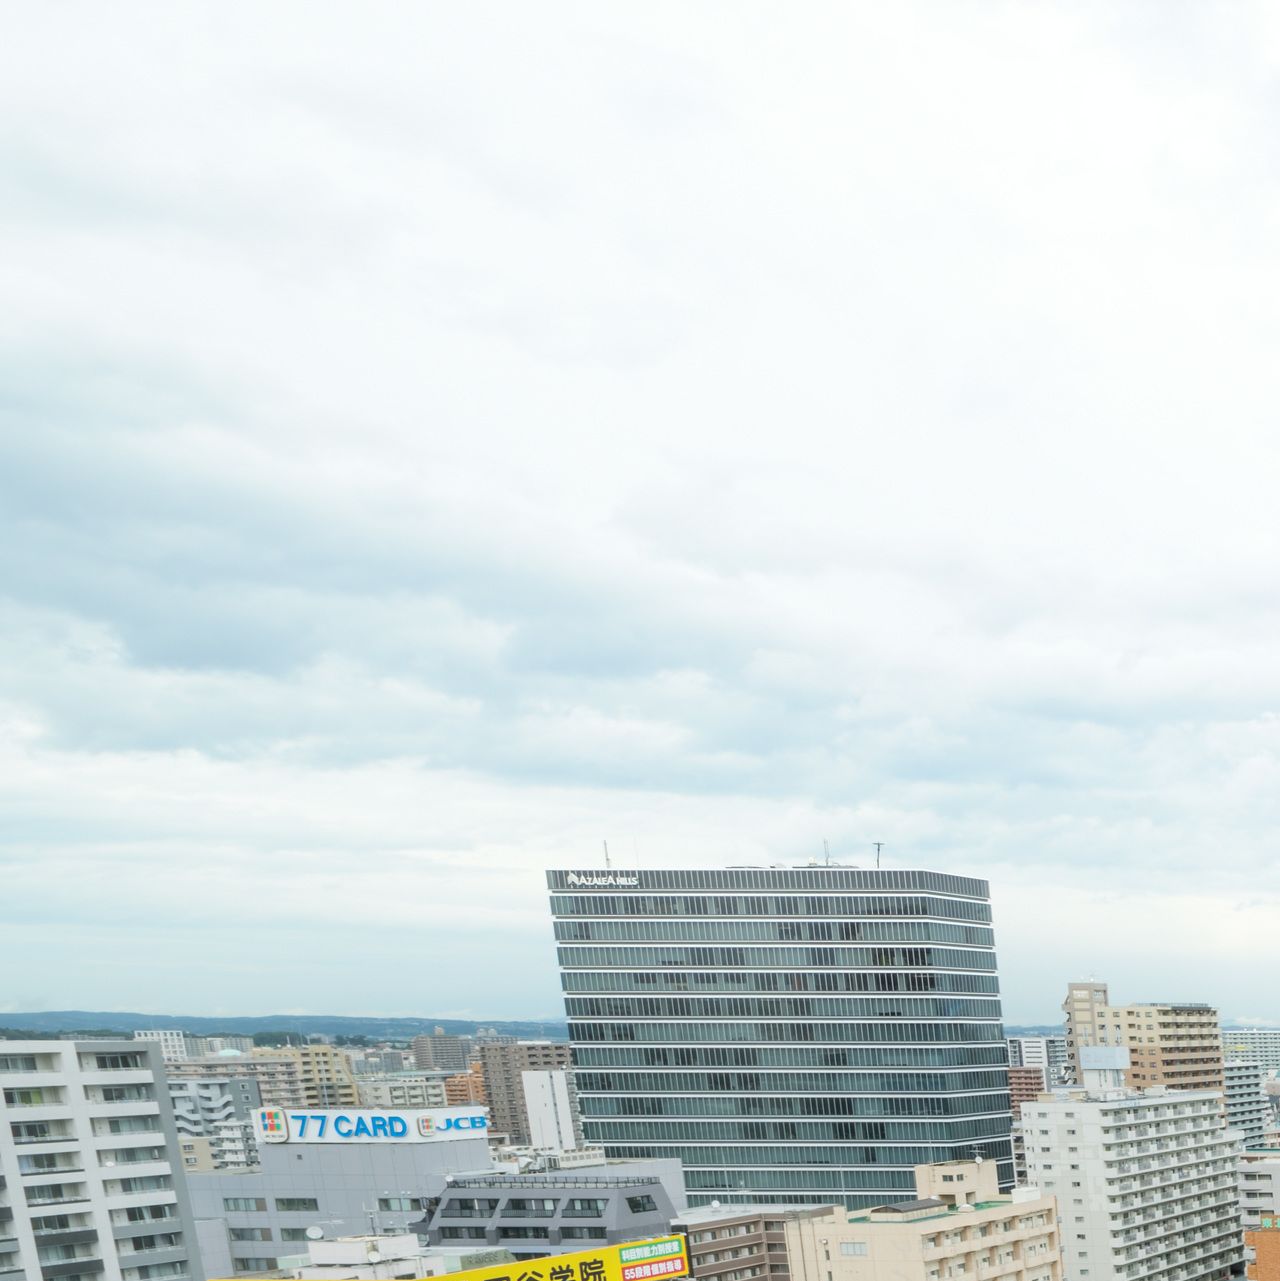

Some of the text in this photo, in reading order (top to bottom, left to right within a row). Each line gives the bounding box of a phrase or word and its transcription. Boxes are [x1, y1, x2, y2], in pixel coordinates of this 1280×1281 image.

[290, 1115, 487, 1137] 77 CARD JCB
